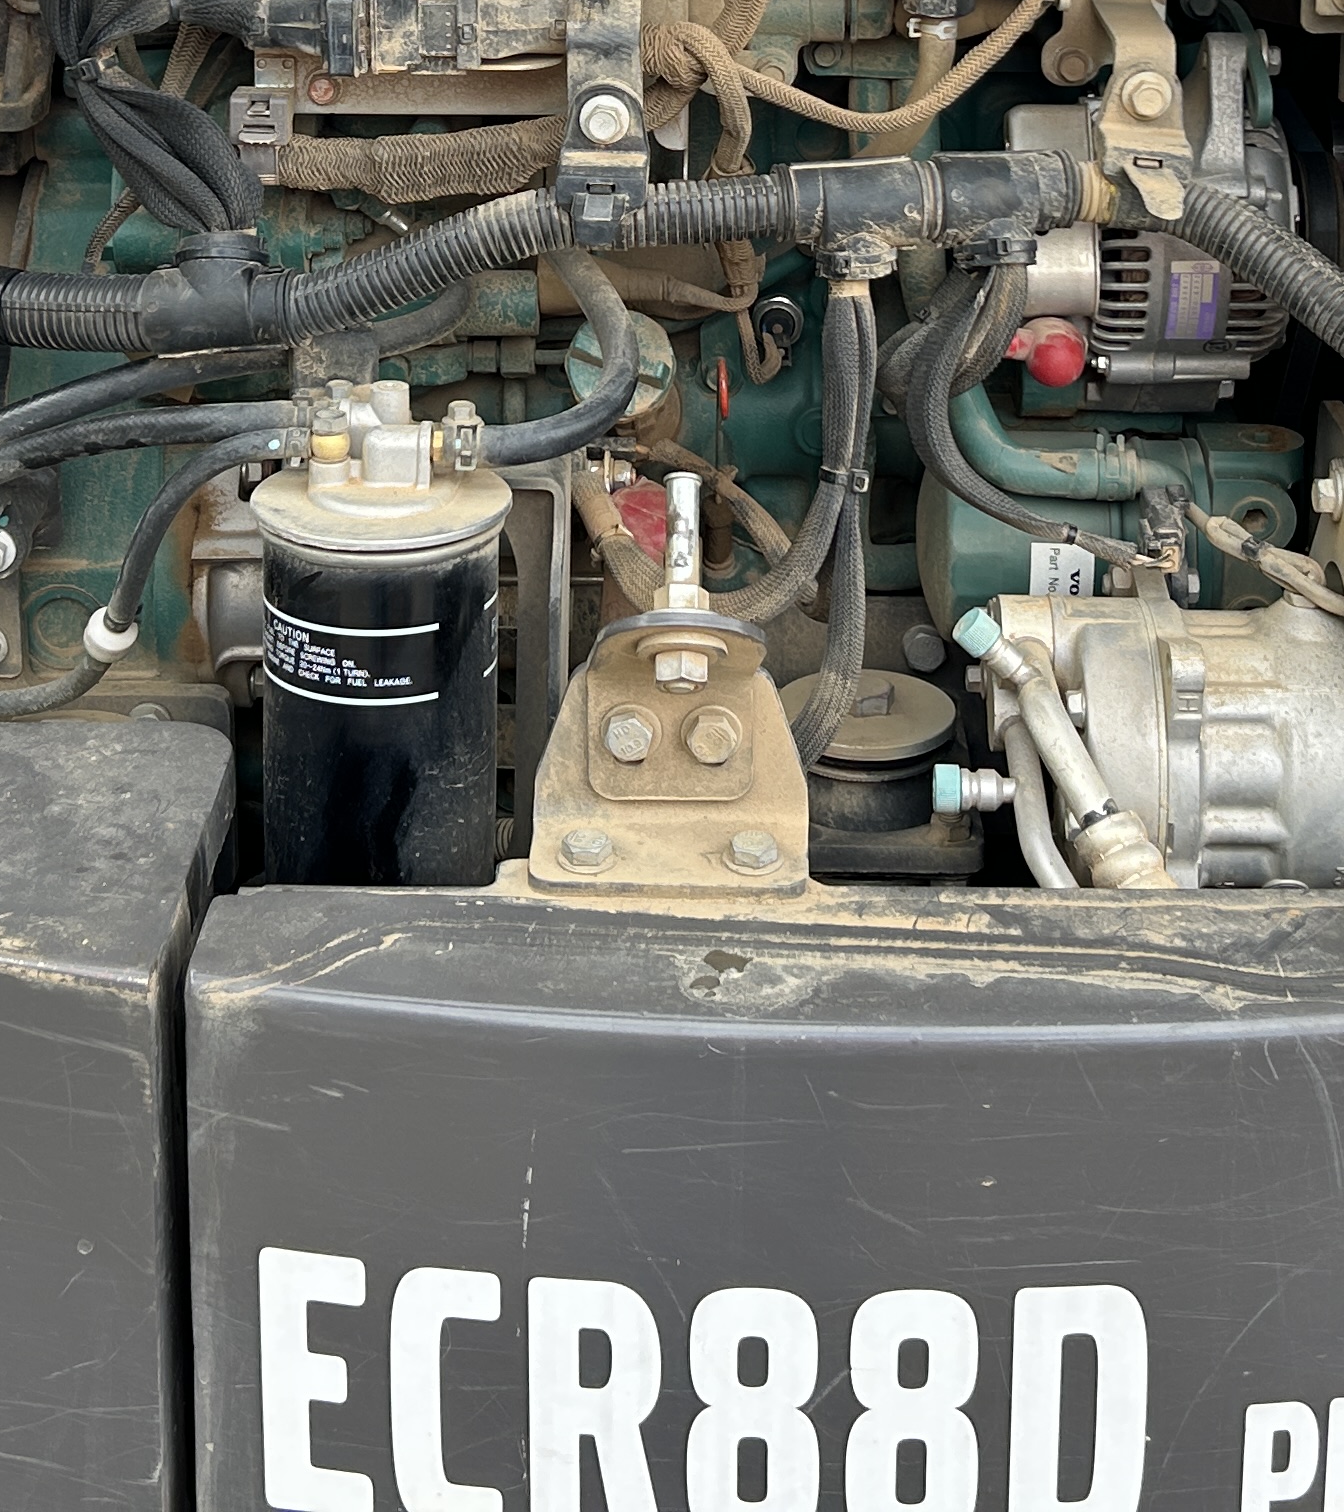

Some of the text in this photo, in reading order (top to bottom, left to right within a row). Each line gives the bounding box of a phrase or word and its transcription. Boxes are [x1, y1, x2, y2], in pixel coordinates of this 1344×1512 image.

[1048, 548, 1060, 570] Part
[273, 619, 310, 643] CAUTION
[324, 675, 342, 685] FOR
[346, 677, 368, 687] FUEL
[258, 1246, 1149, 1512] ECR88D
